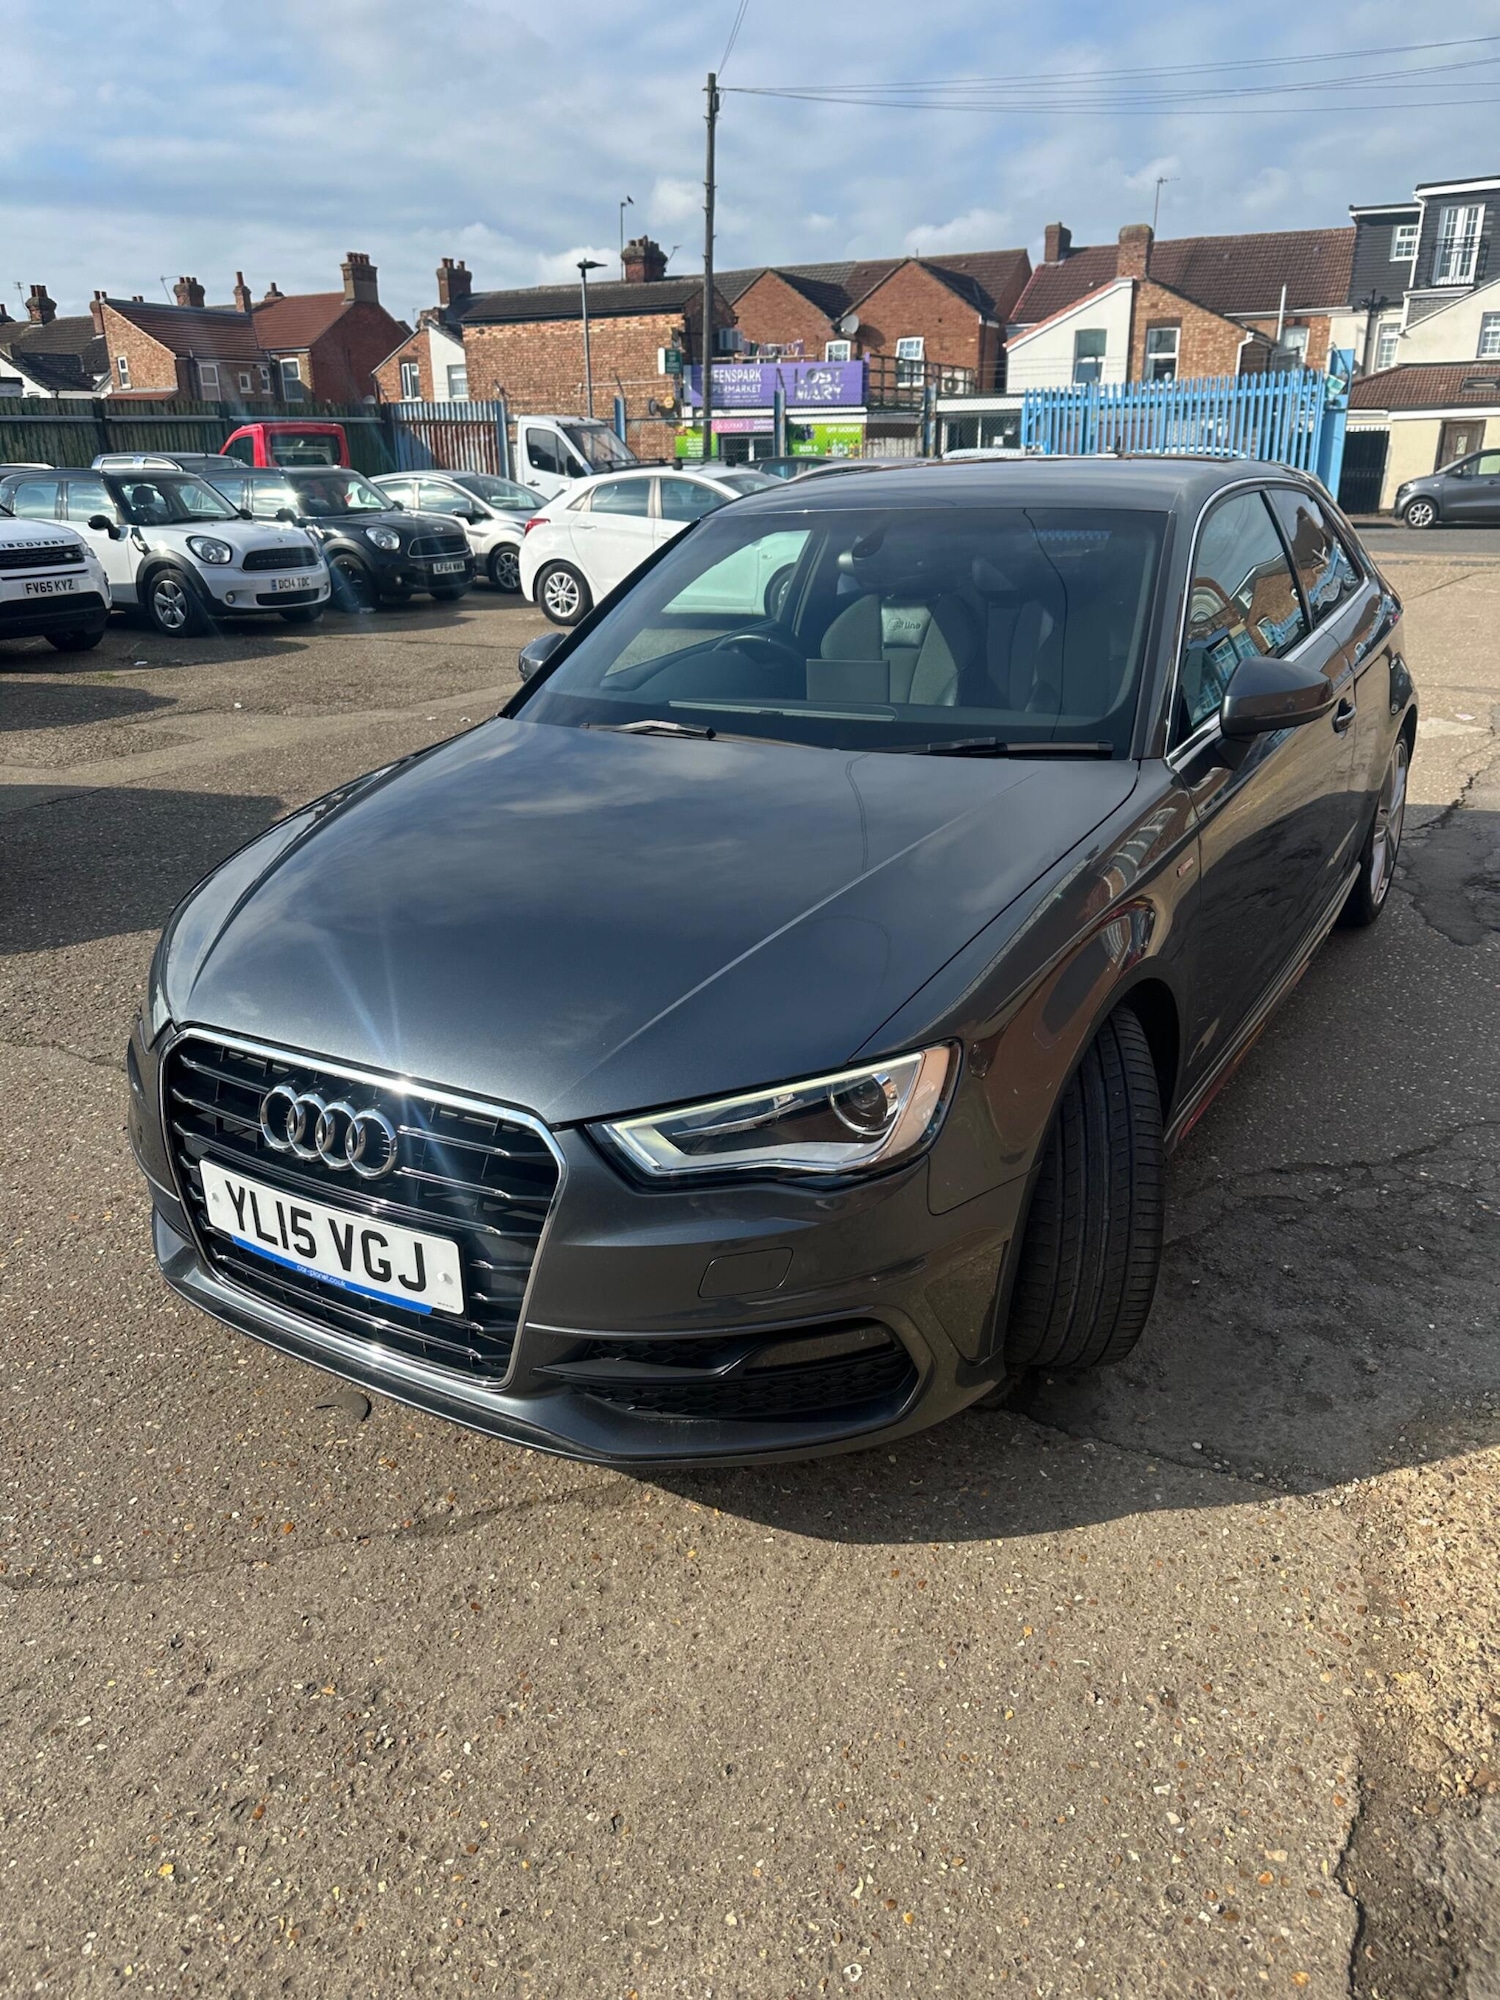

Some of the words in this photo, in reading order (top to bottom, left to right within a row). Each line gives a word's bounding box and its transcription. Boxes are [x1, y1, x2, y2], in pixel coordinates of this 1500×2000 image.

[712, 368, 762, 383] EENSPARK
[712, 383, 762, 394] PERMARKET
[795, 383, 845, 401] MARY
[0, 539, 65, 549] ISCOVERY
[25, 581, 53, 595] FV65
[225, 1179, 317, 1259] YL15
[327, 1217, 426, 1293] VGJ
